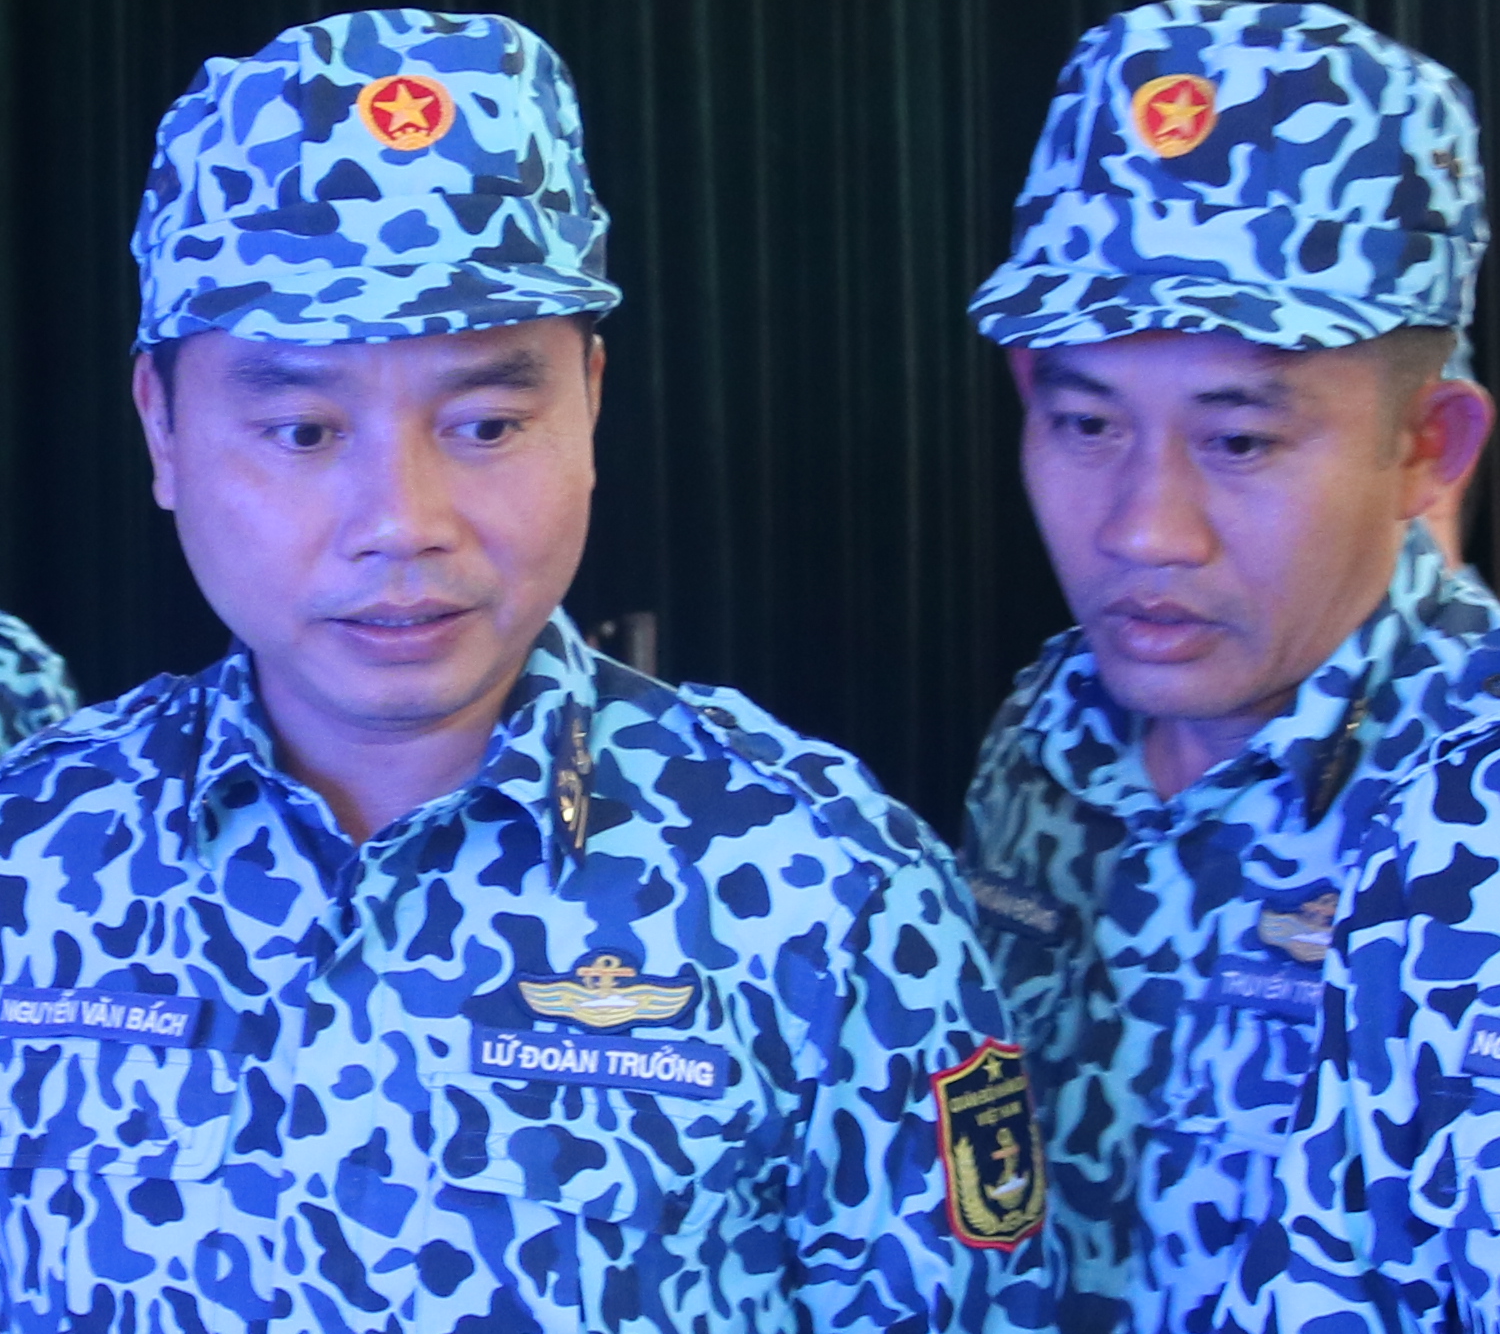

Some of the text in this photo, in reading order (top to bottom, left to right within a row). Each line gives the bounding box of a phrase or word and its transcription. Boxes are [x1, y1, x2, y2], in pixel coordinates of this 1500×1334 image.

[81, 996, 127, 1029] VĂN
[124, 1000, 189, 1037] BÁCH
[517, 1039, 600, 1074] ĐOÀN
